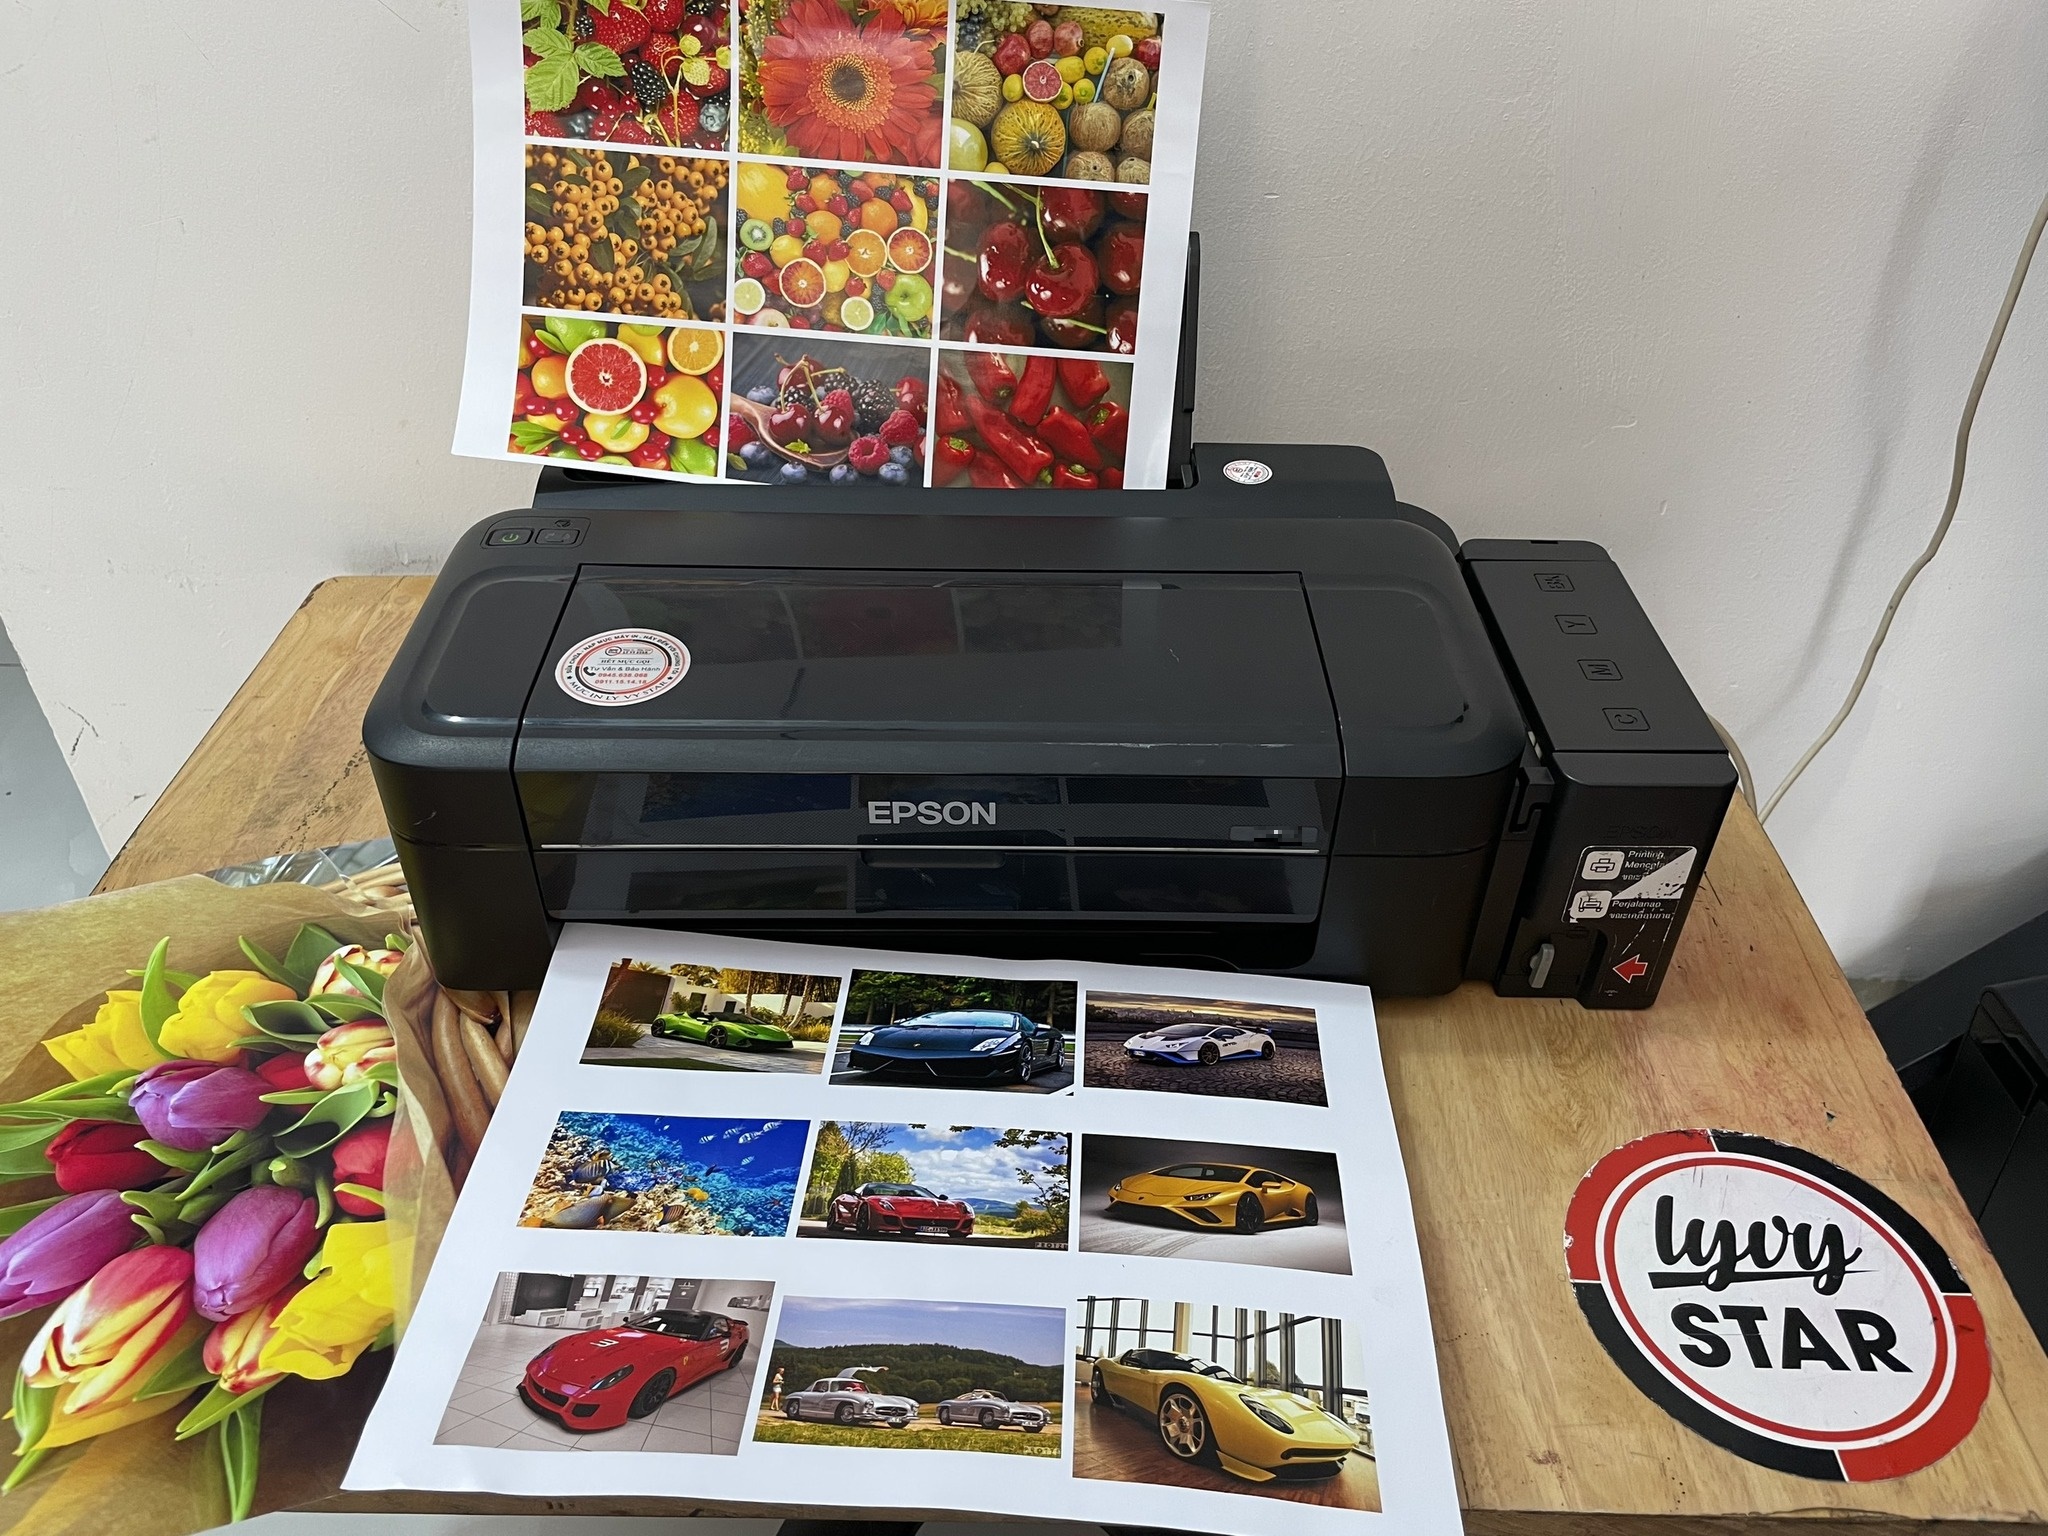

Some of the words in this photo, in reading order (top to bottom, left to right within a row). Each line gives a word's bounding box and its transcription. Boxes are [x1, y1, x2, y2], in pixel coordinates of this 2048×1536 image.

[1587, 664, 1612, 676] M
[642, 681, 669, 695] STAR
[1614, 713, 1638, 724] C
[867, 800, 997, 825] EPSON
[1670, 1302, 1914, 1373] STAR
